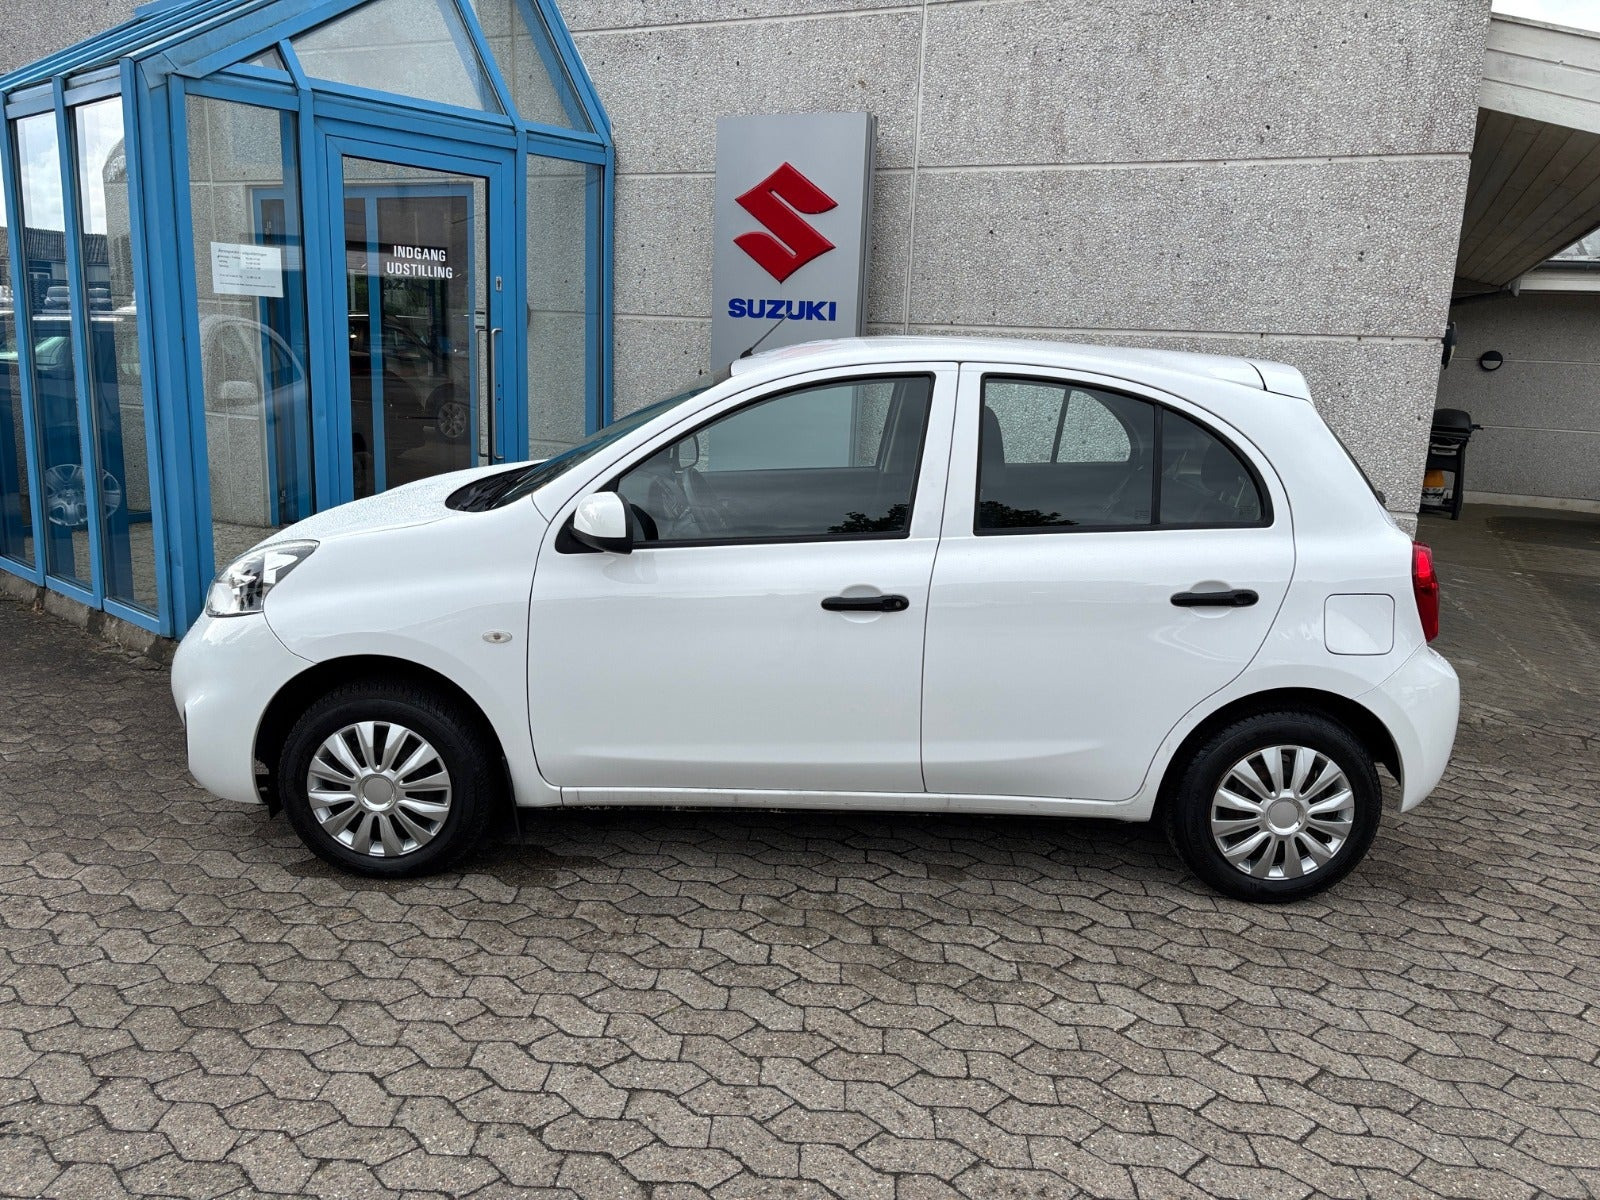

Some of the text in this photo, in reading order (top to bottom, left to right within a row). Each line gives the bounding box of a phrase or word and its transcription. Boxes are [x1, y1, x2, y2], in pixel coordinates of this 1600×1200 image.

[394, 245, 446, 262] INDGANG
[386, 262, 453, 279] UDSTILLING
[728, 298, 836, 321] SUZUKI
